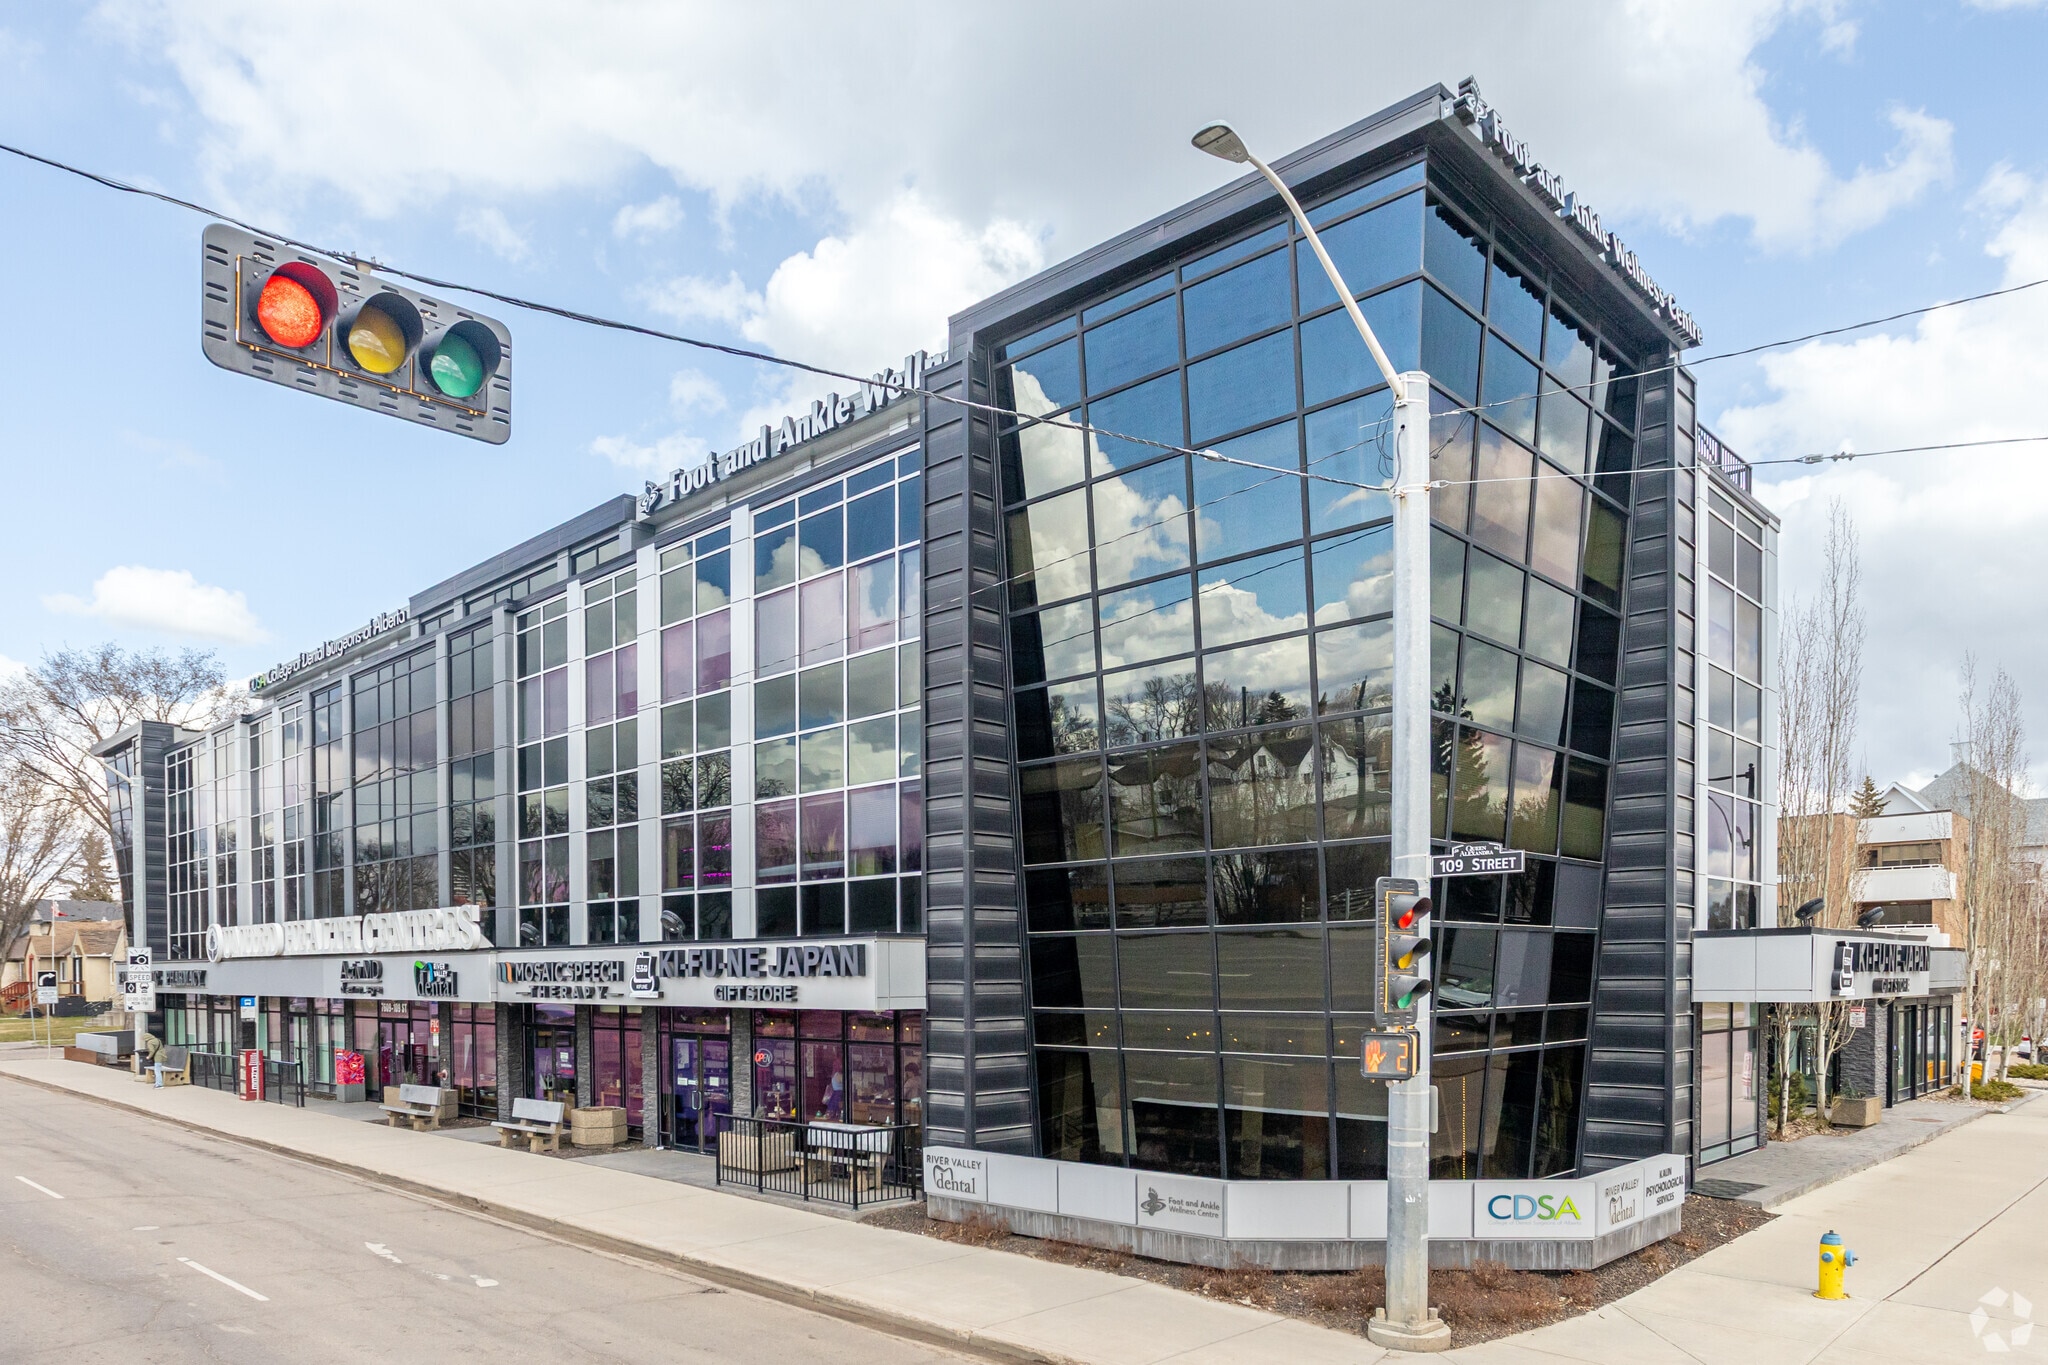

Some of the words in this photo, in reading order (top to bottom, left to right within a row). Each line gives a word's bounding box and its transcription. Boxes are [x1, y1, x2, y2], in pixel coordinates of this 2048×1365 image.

[1492, 109, 1531, 174] Foot
[1536, 163, 1566, 208] and
[1571, 191, 1611, 251] Ankle
[1612, 232, 1666, 308] Wellness
[1667, 293, 1704, 346] Centre
[669, 451, 719, 501] Foot
[724, 424, 772, 477] and
[777, 392, 855, 453] Ankle
[267, 663, 293, 682] College
[300, 641, 326, 667] Dental
[326, 632, 363, 657] Surgeons
[373, 609, 408, 635] Alberta
[1440, 859, 1463, 873] 109
[1472, 857, 1516, 871] STREET
[768, 944, 863, 978] JAPAN
[1902, 944, 1930, 972] JAPAN
[166, 970, 207, 987] PHARMACY
[515, 962, 563, 982] MOSAIC
[566, 960, 622, 982] SPEECH
[418, 971, 456, 997] dental
[529, 985, 609, 999] THERAPY
[714, 985, 743, 1001] GIFT
[746, 985, 795, 1001] STORE
[755, 1051, 771, 1063] OPEN
[1396, 1042, 1409, 1072] 2
[926, 1154, 949, 1166] RIVER
[951, 1157, 982, 1170] VALLEY
[936, 1172, 976, 1195] dental
[1605, 1184, 1620, 1197] RIVER
[1620, 1178, 1640, 1192] VALLEY
[1646, 1175, 1685, 1198] PSYCHOLOGICAL
[1168, 1196, 1184, 1206] Foot
[1185, 1200, 1199, 1208] and
[1200, 1201, 1220, 1211] Ankle
[1488, 1195, 1581, 1220] CDSA
[1656, 1192, 1675, 1206] SERVICES
[1169, 1205, 1196, 1216] Wellness
[1197, 1209, 1219, 1218] Centre
[1611, 1198, 1635, 1225] dental
